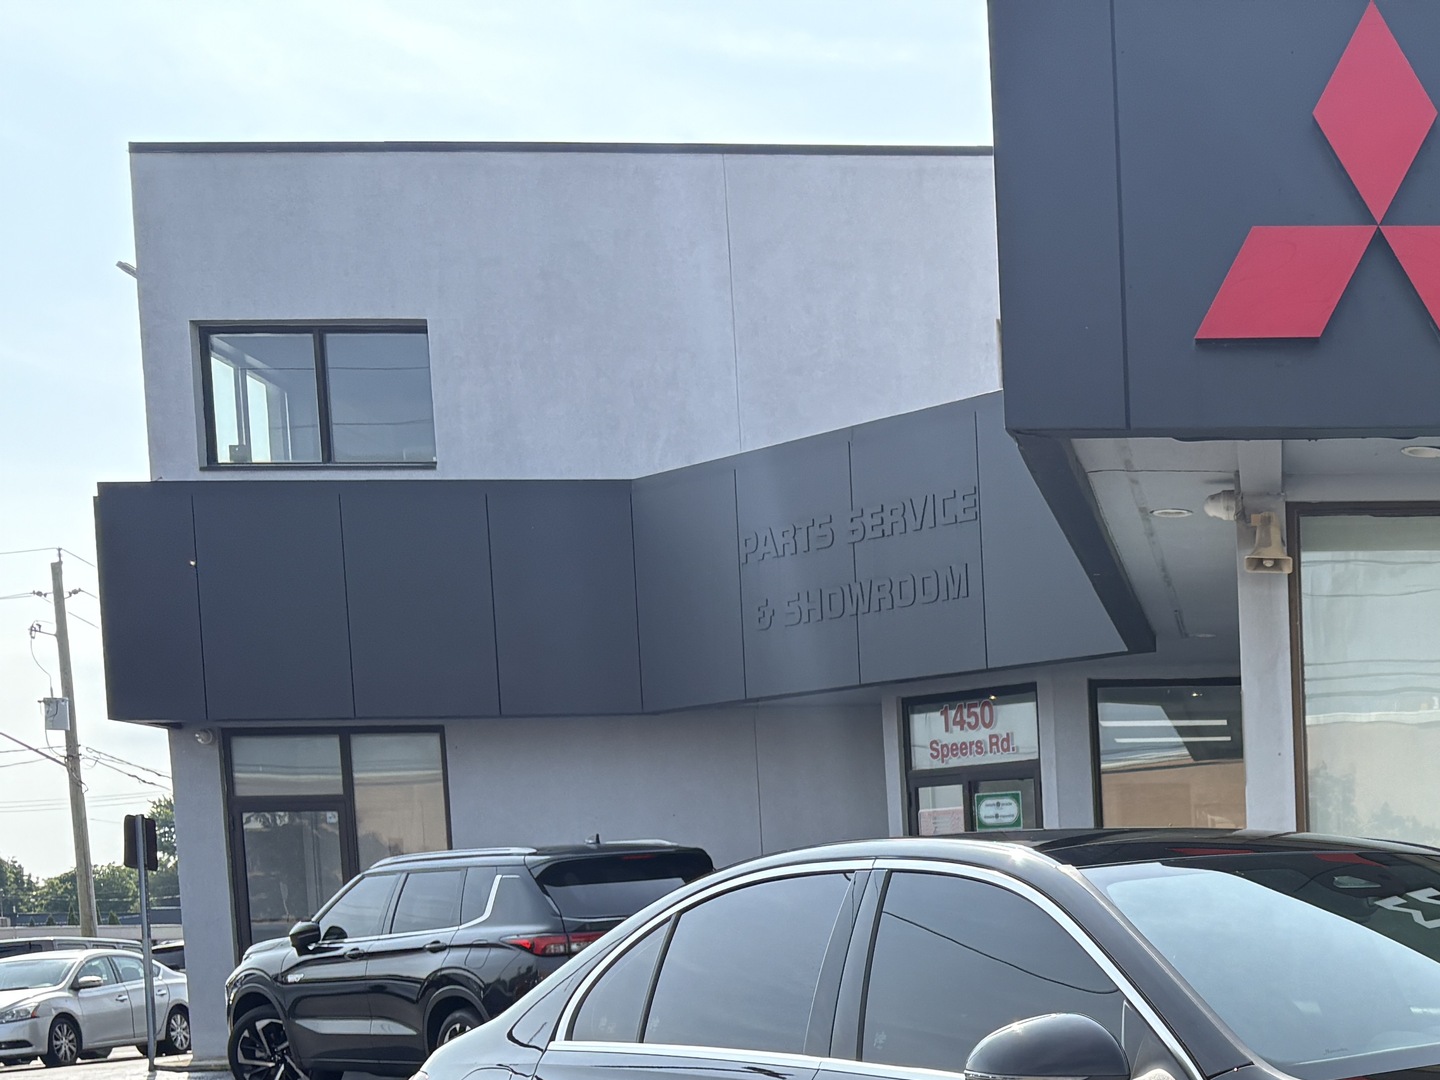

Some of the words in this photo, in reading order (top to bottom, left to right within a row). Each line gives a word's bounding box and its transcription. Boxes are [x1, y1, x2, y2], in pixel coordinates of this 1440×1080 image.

[741, 513, 835, 566] PARTS
[848, 485, 978, 545] SERVICE
[757, 598, 775, 631] &
[784, 562, 970, 627] SHOWROOM
[940, 699, 996, 733] 1450
[929, 739, 985, 764] Speers
[988, 732, 1017, 754] Rd.
